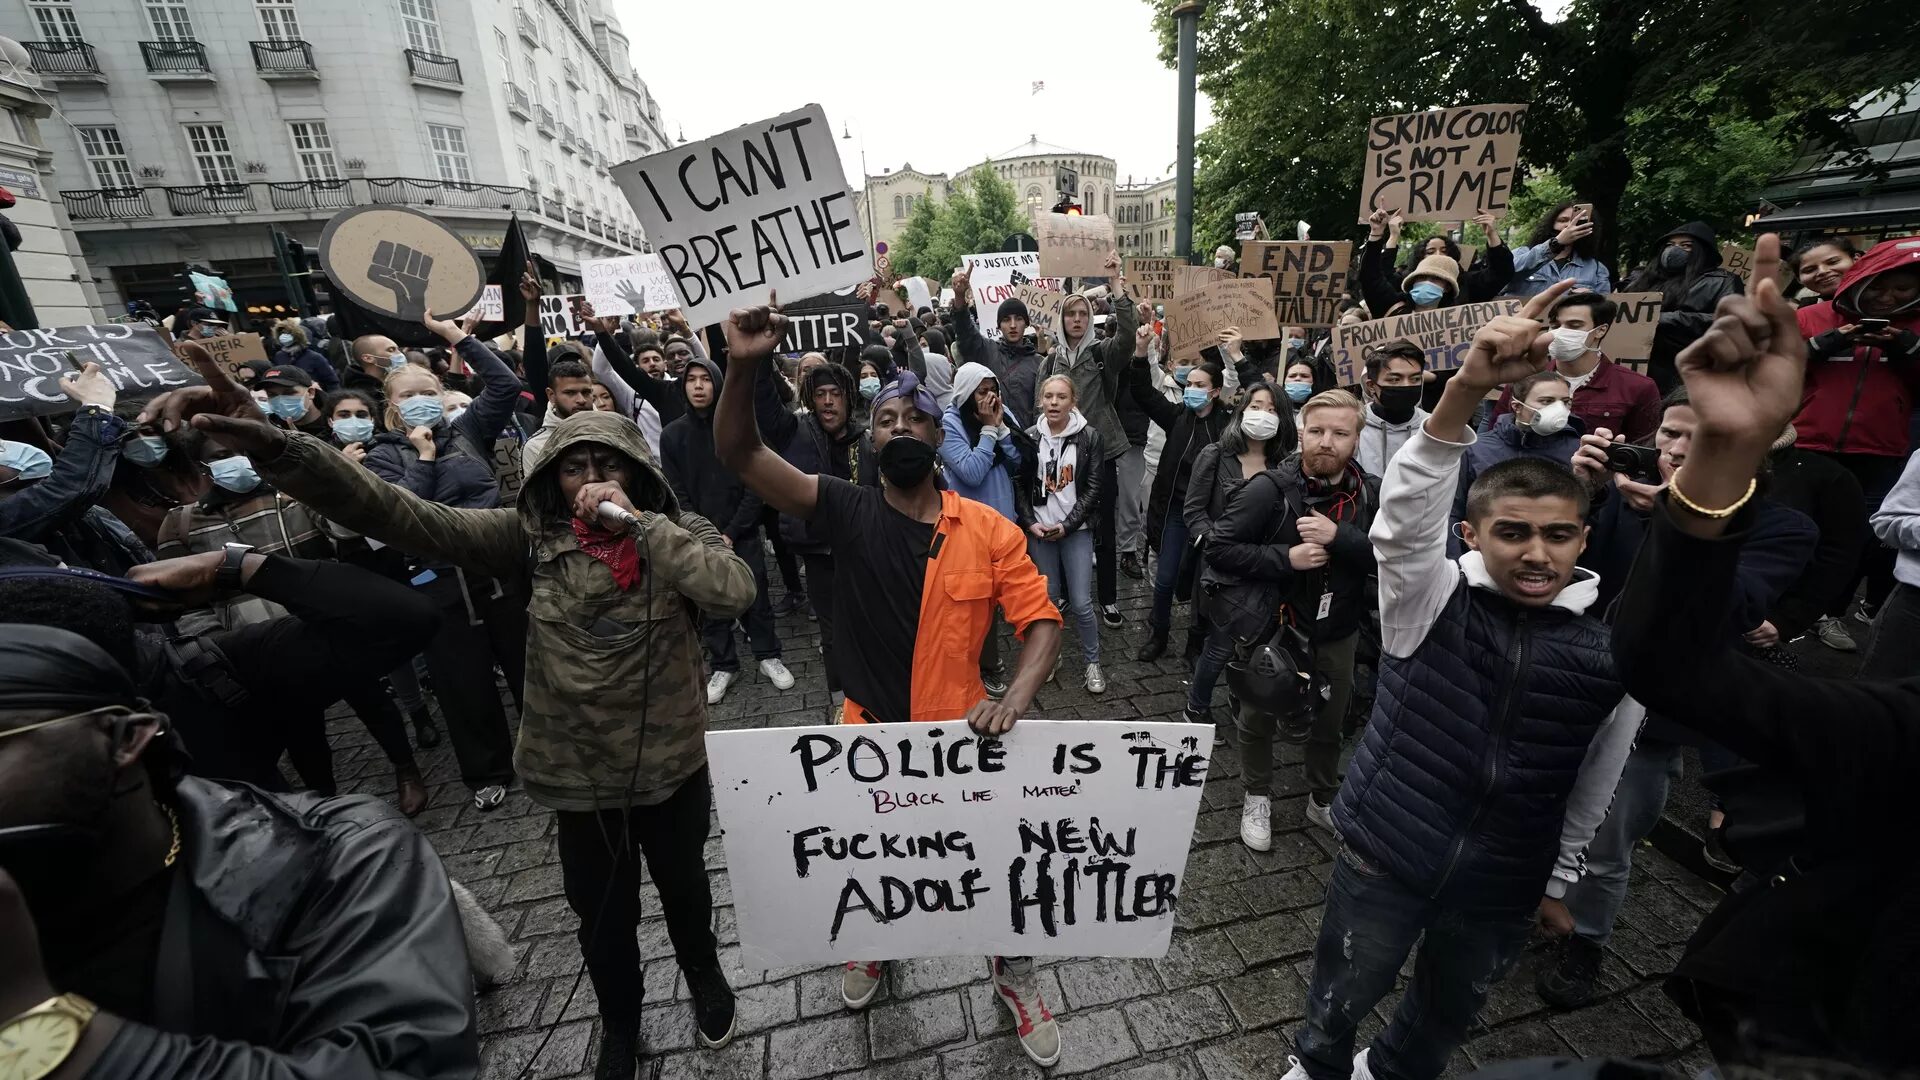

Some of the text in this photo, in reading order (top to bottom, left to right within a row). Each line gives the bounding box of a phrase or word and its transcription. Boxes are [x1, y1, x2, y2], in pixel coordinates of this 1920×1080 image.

[1369, 109, 1527, 151] SKIN COLOR
[639, 117, 812, 223] I CAN'T
[1376, 140, 1496, 178] IS NOT A
[1369, 167, 1512, 216] CRIME
[659, 190, 865, 308] BREATHE
[984, 256, 1018, 269] JUSTICE
[1021, 254, 1034, 265] NO
[1262, 244, 1334, 273] END
[590, 264, 622, 278] STOP
[540, 297, 562, 313] NO
[1020, 288, 1048, 308] PIGS
[1274, 297, 1341, 324] TALITY
[541, 314, 566, 335] NO
[1340, 321, 1388, 348] FROM
[1337, 350, 1353, 366] 2
[1419, 330, 1446, 350] WE
[1339, 365, 1355, 384] 4
[791, 729, 1207, 792] POLICE IS THE
[792, 816, 1137, 878] FUCKING NEW
[829, 854, 1178, 949] ADOLF HITLER
